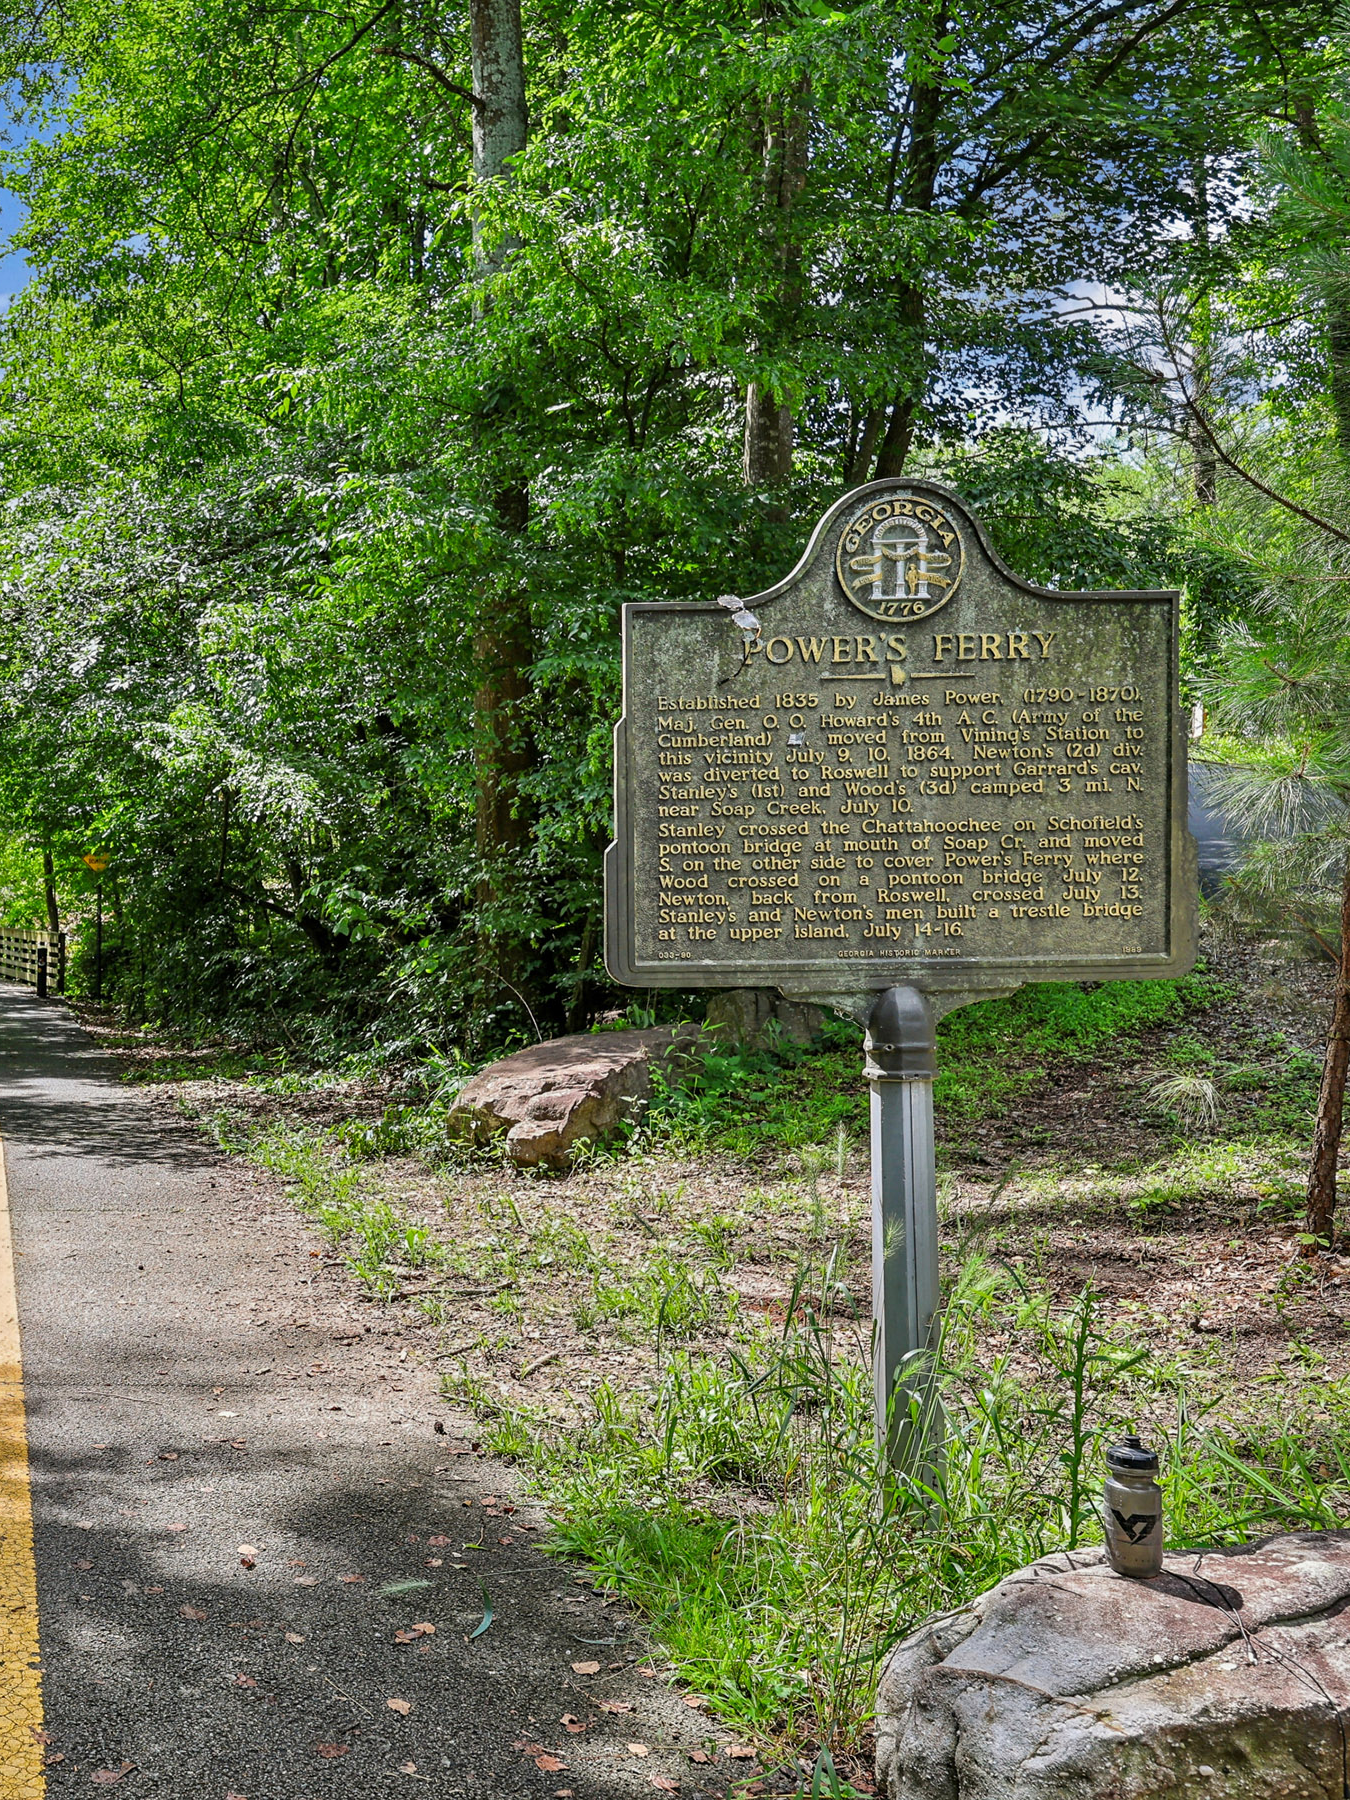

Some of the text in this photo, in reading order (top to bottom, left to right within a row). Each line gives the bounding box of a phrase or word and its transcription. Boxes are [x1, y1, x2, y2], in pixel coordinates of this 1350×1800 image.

[845, 501, 955, 553] GEORGIA
[877, 601, 925, 616] 1776
[742, 631, 1056, 665] POWER'S FERRY
[658, 695, 761, 711] Established
[775, 692, 819, 709] 1835
[834, 693, 857, 709] by
[873, 692, 929, 707] James
[658, 716, 697, 733] Maj.
[710, 715, 750, 730] Gen.
[763, 714, 780, 729] O.
[789, 713, 807, 729] O.
[820, 710, 900, 728] Howard's
[912, 711, 942, 727] 4th
[1011, 708, 1069, 726] (Army
[1081, 708, 1101, 724] of
[1115, 707, 1143, 722] the
[658, 725, 1144, 749] Cumberland) moved from Vining's Station to
[658, 750, 692, 766] this
[704, 749, 773, 766] vicinity
[786, 748, 825, 765] July
[906, 746, 954, 761] 1864.
[973, 743, 1054, 760] Newton's
[1066, 742, 1101, 759] (2d)
[1113, 741, 1144, 757] div.
[658, 759, 1144, 783] was diverted to Roswell to support Garrard's cav.
[658, 784, 738, 801] Stanley's
[798, 782, 831, 798] and
[845, 780, 906, 797] Wood's
[919, 780, 957, 796] (3d)
[970, 779, 1043, 797] camped
[1059, 777, 1071, 793] 3
[1085, 777, 1113, 793] mi.
[1127, 777, 1144, 792] N.
[658, 803, 699, 817] near
[711, 801, 755, 819] Soap
[840, 798, 880, 816] July
[658, 814, 1144, 839] Stanley crossed the Chattahoochee on Schofield's
[658, 832, 1144, 857] pontoon bridge at mouth of Soap Cr. and moved
[658, 850, 1144, 872] S. on the other side to cover Power's Ferry where
[659, 873, 709, 889] Wood
[728, 872, 799, 888] crossed
[818, 873, 841, 887] on
[859, 873, 870, 886] a
[888, 872, 963, 888] pontoon
[982, 869, 1042, 887] bridge
[1063, 867, 1102, 884] July
[751, 890, 794, 906] back
[813, 889, 858, 905] from
[972, 886, 1044, 902] crossed
[1062, 885, 1101, 902] July
[1121, 884, 1143, 900] 13.
[658, 902, 1143, 925] Stanley's and Newton's men built a trestle bridge
[658, 927, 675, 941] at
[688, 926, 717, 940] the
[729, 926, 783, 942] upper
[863, 922, 901, 940] July
[913, 921, 964, 937] 14-16.
[838, 948, 961, 958] GEORGIA HISTORIC MARKER
